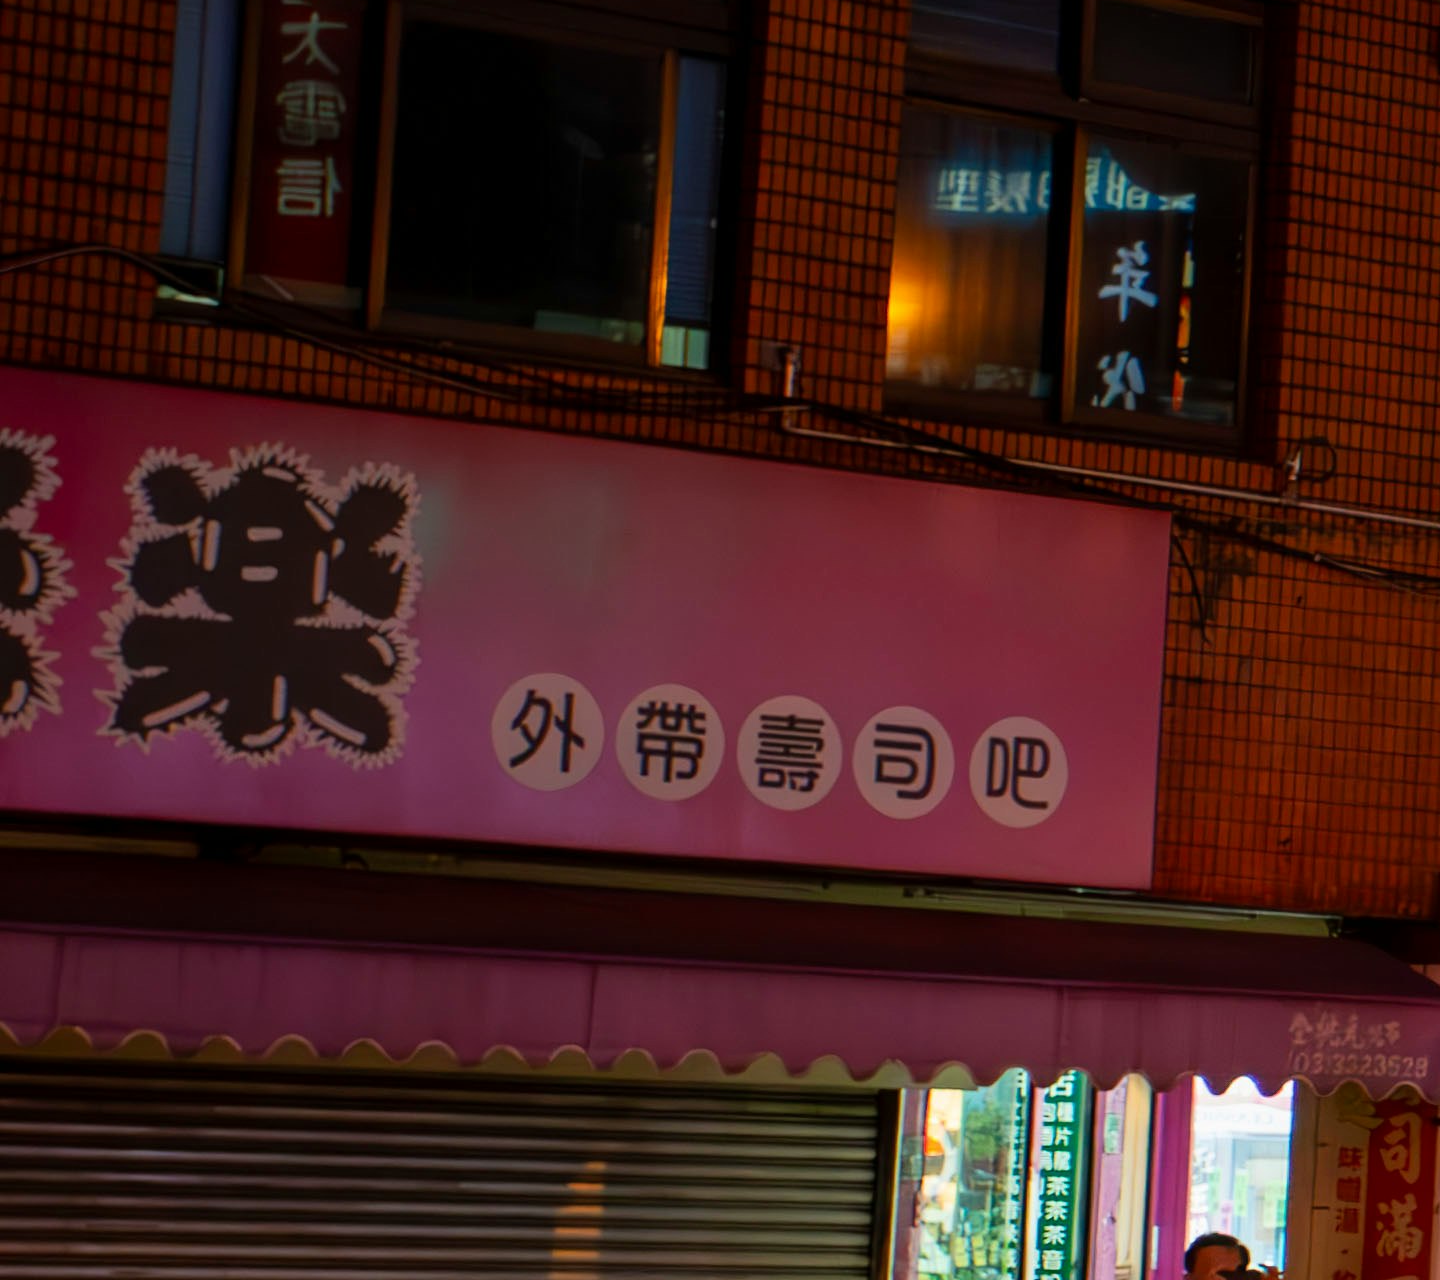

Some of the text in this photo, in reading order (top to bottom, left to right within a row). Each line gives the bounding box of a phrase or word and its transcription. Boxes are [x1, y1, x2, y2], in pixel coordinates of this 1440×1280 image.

[509, 687, 1050, 811] 外帶壽司吧
